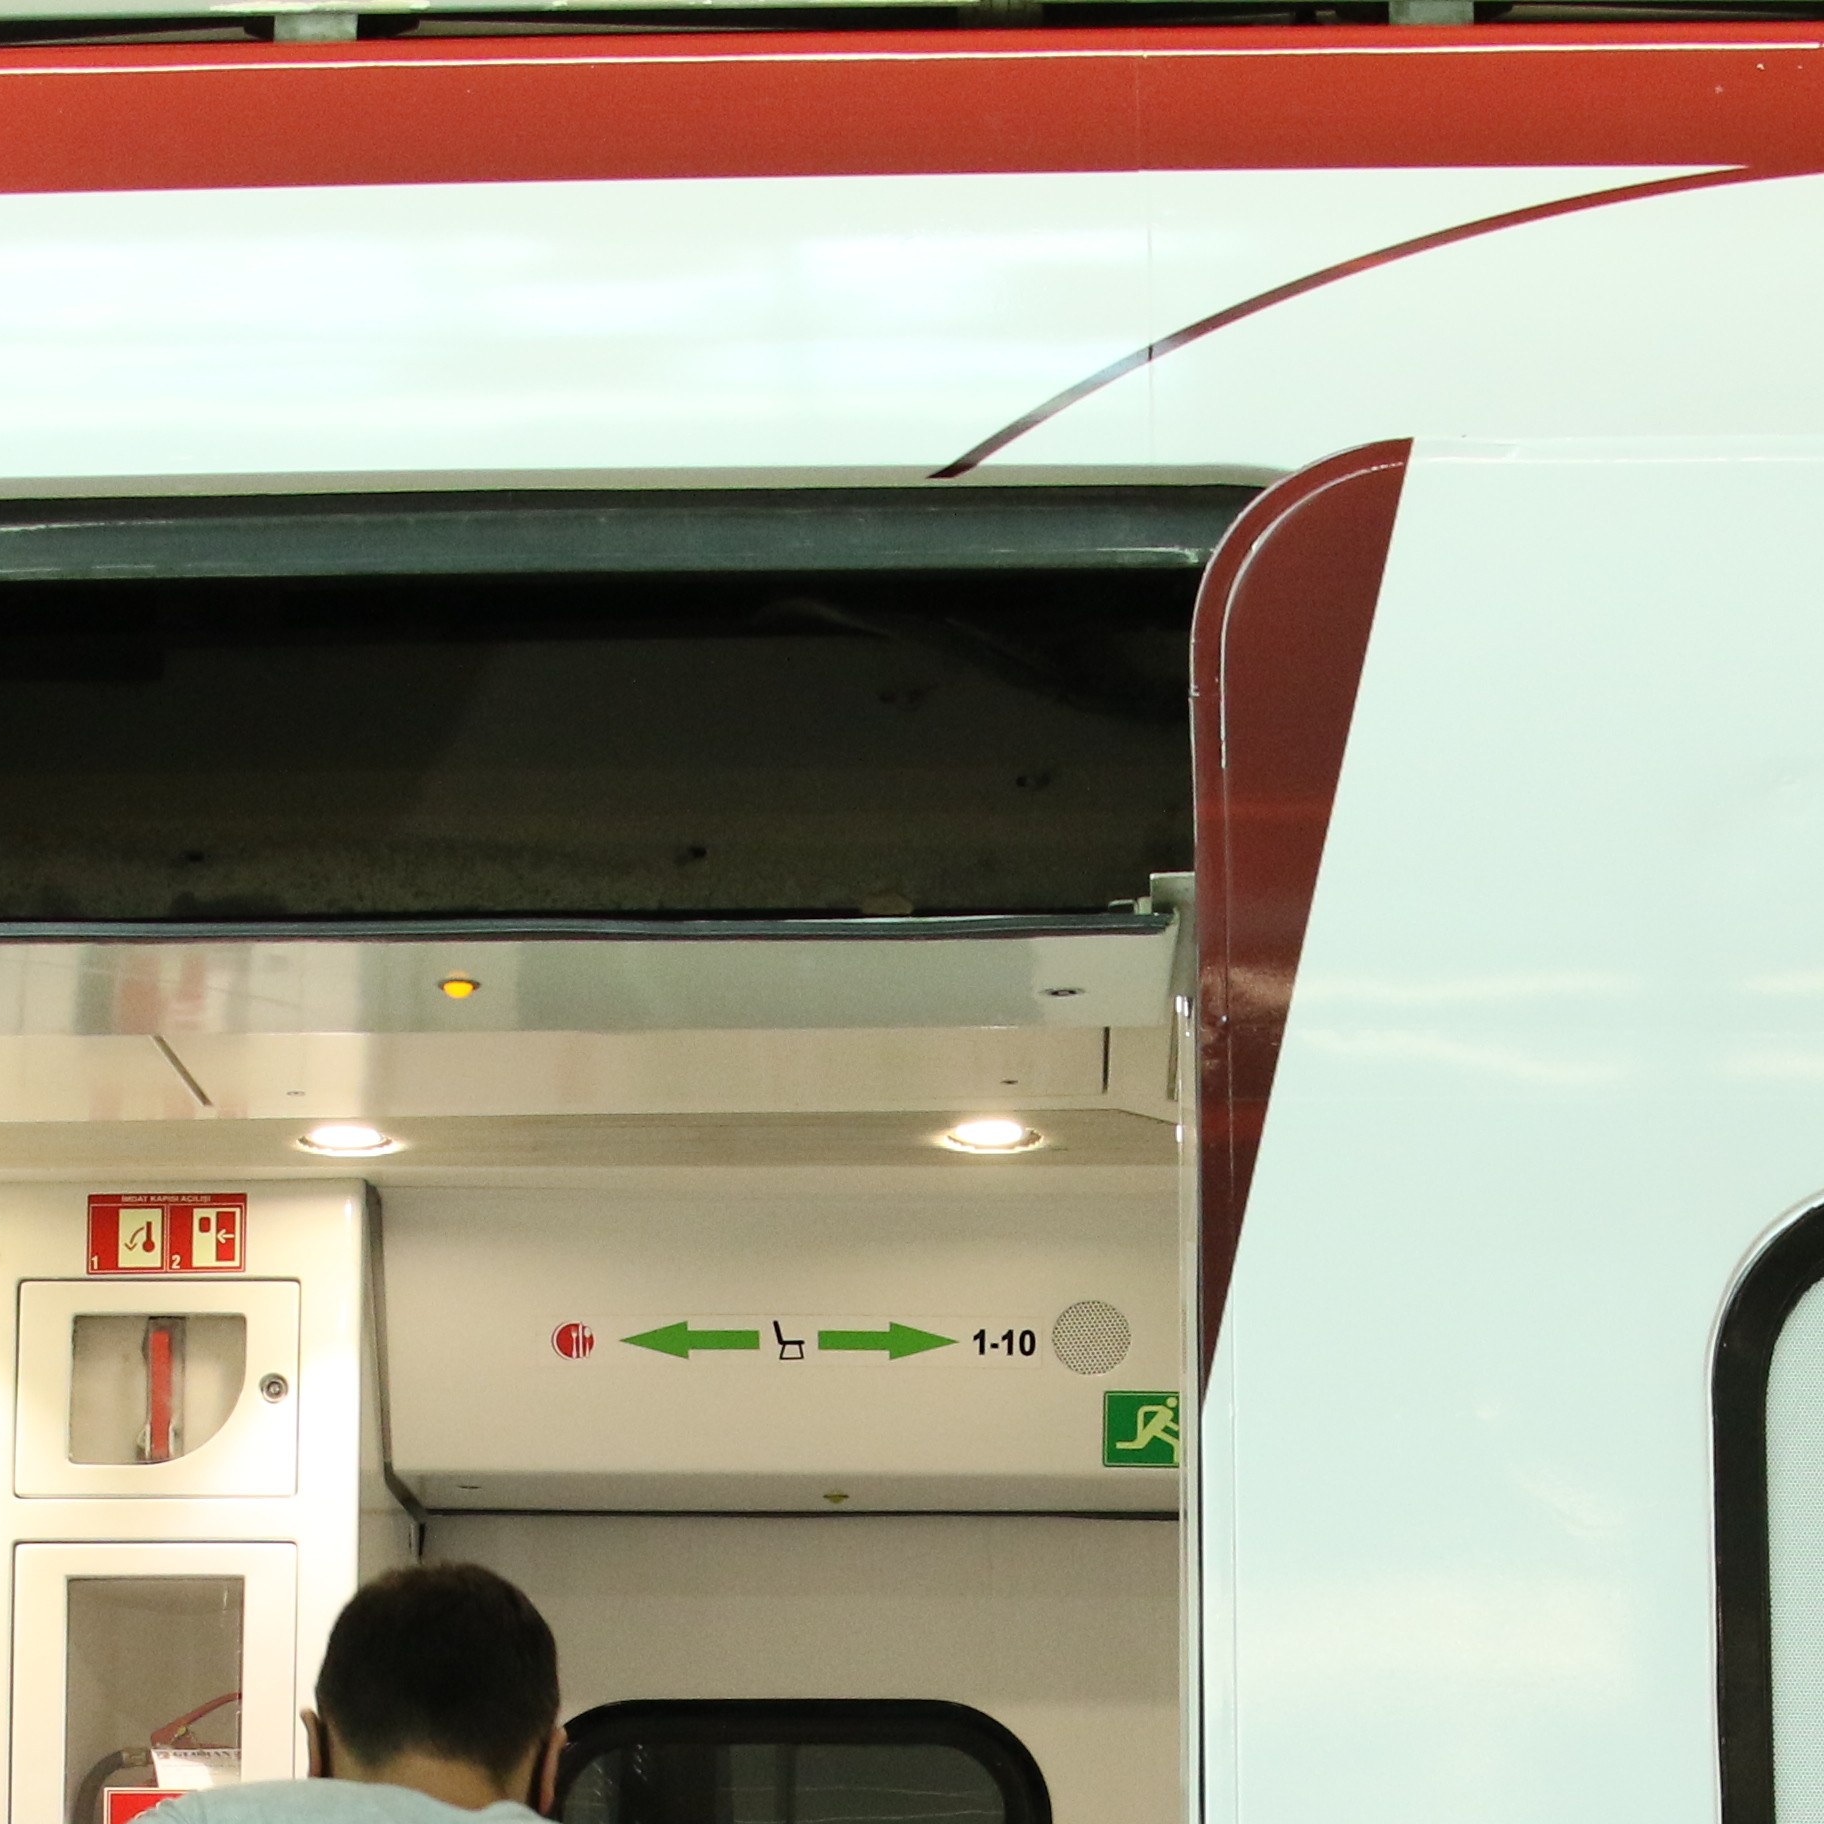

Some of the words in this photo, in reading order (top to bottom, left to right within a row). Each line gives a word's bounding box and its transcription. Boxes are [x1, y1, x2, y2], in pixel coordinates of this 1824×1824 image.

[91, 1256, 99, 1270] 1
[171, 1255, 181, 1269] 2
[973, 1328, 1036, 1356] 1-10
